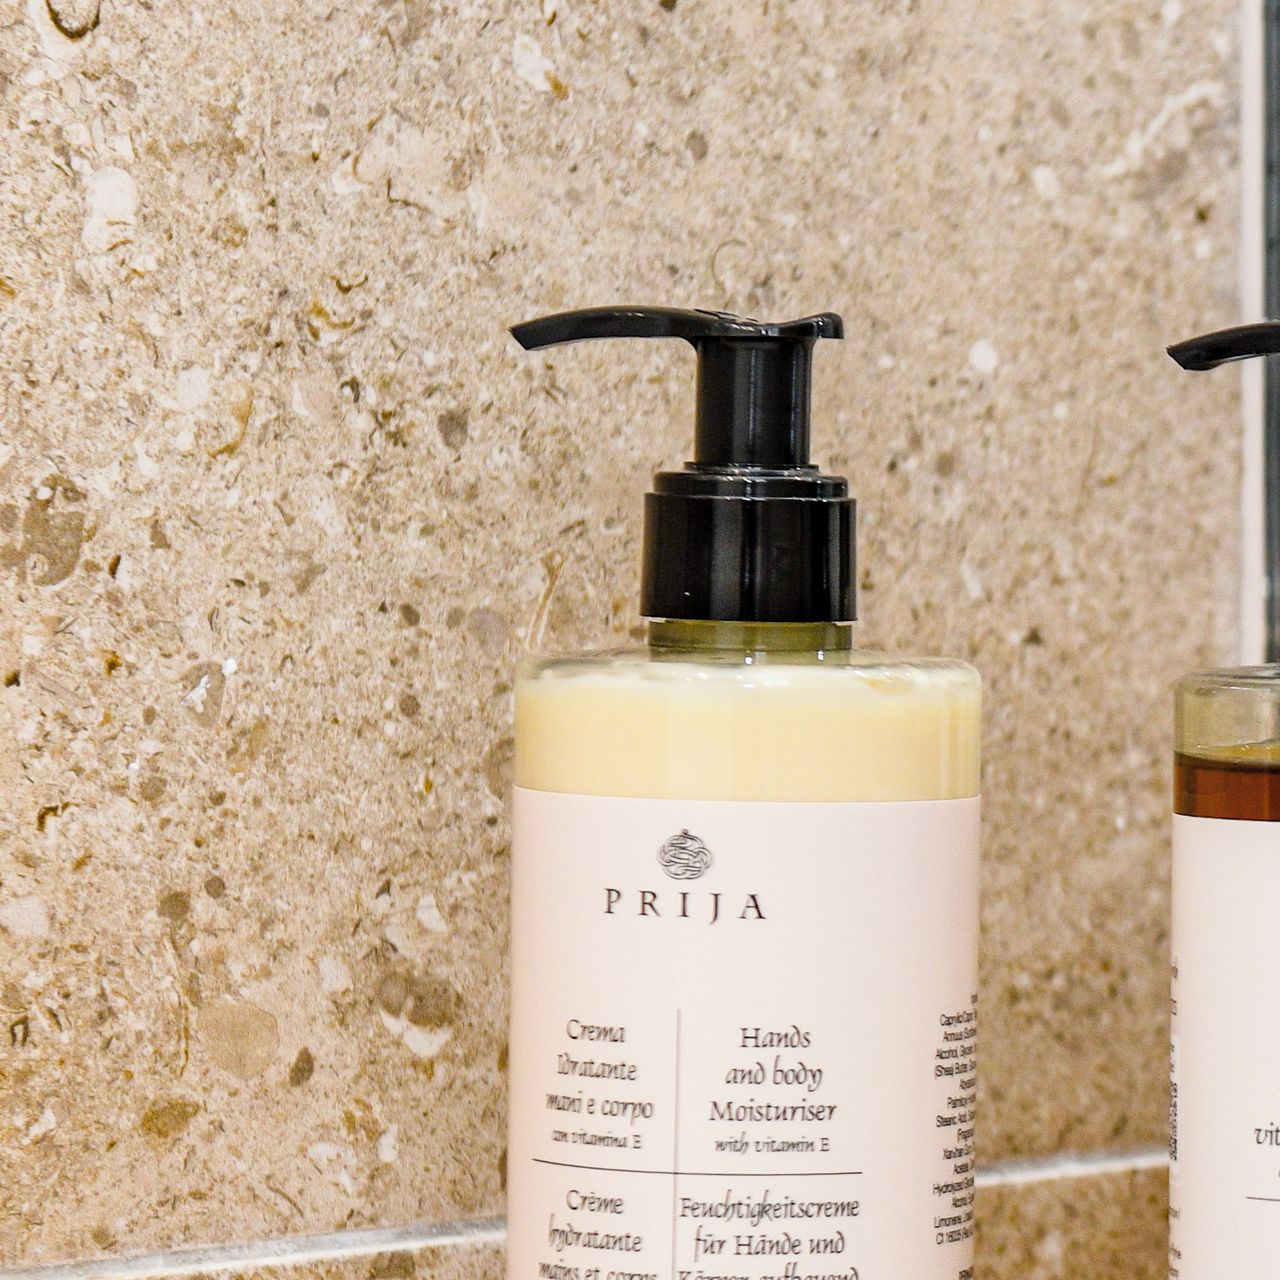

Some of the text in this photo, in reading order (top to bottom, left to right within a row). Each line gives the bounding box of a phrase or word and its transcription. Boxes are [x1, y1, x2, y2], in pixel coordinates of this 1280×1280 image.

[604, 888, 767, 925] PRIJA
[567, 1019, 625, 1043] Crema
[739, 1025, 811, 1048] Hands
[557, 1052, 637, 1081] Idratante
[725, 1055, 823, 1092] and body
[546, 1091, 654, 1125] mani e corpo
[708, 1098, 837, 1122] Moisturiser
[571, 1129, 627, 1148] vitamina
[632, 1134, 642, 1149] E
[715, 1131, 830, 1154] with vitamin E
[679, 1189, 860, 1228] Feuchtigkeitscreme
[694, 1225, 845, 1262] für Hände und
